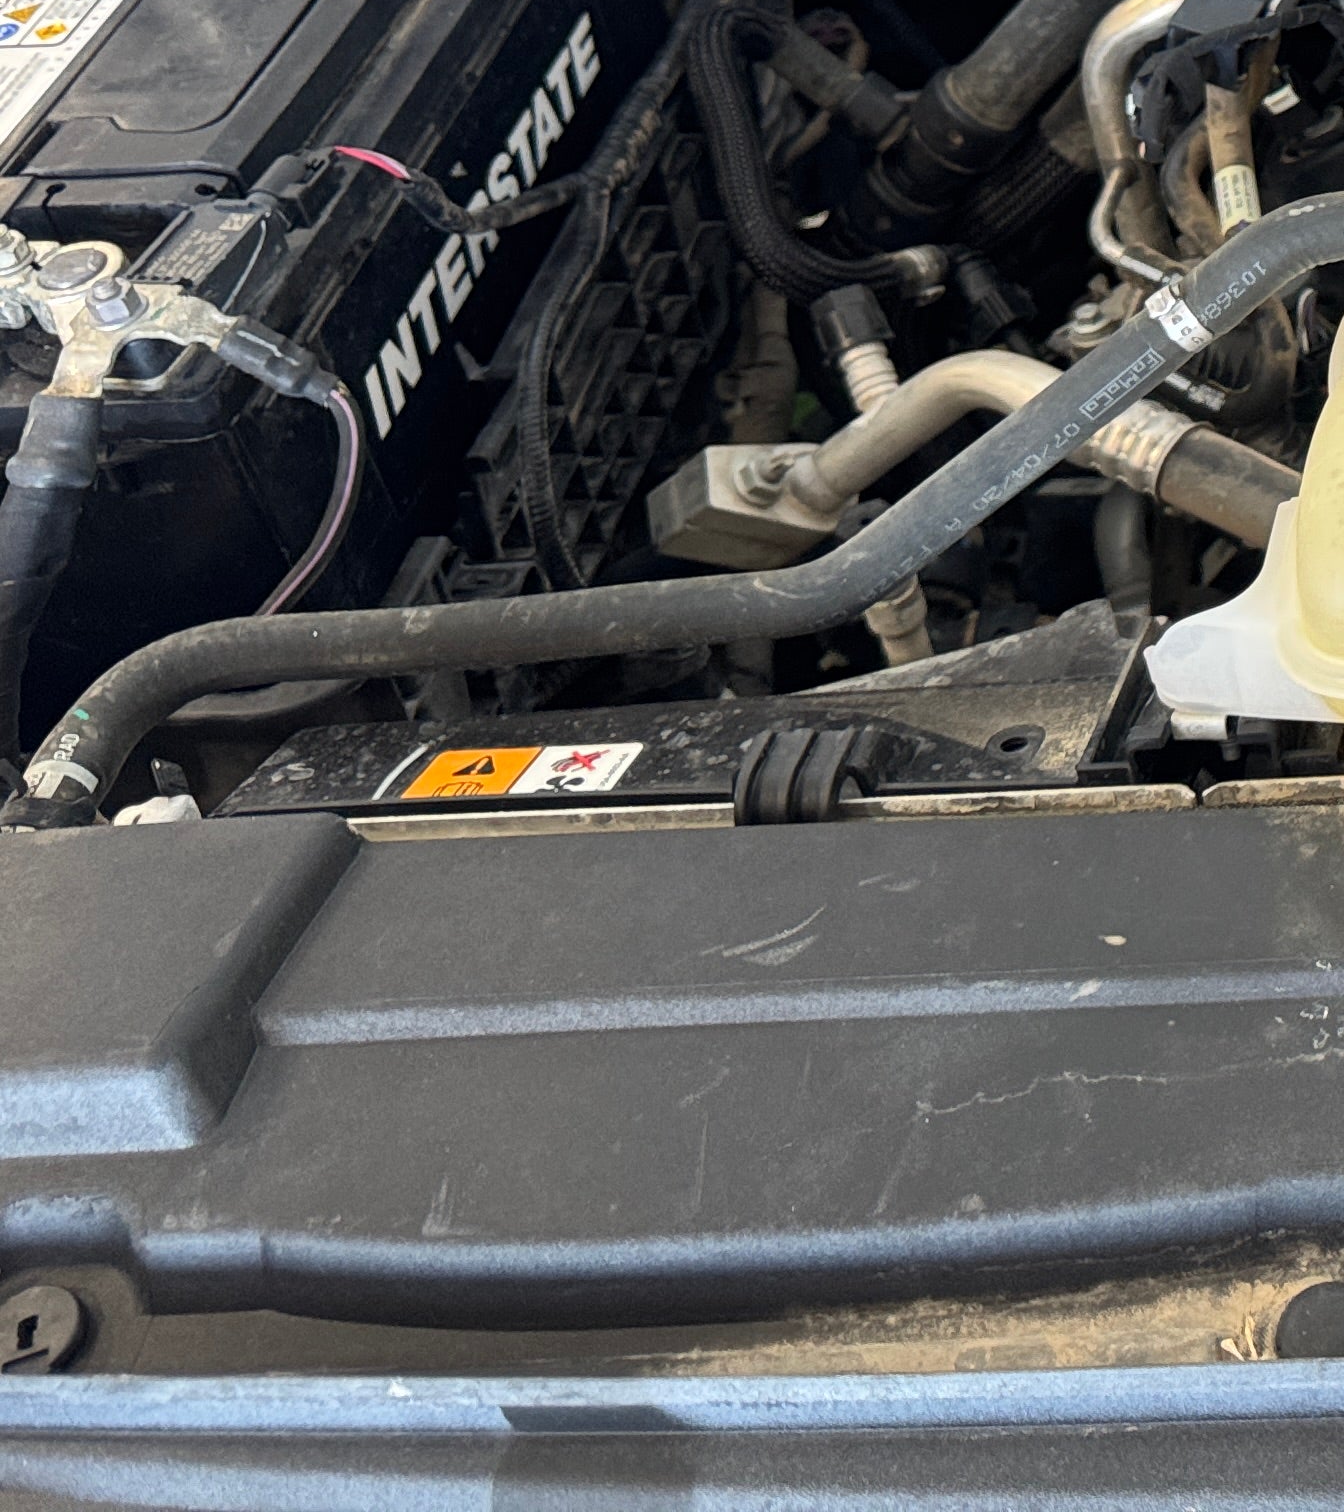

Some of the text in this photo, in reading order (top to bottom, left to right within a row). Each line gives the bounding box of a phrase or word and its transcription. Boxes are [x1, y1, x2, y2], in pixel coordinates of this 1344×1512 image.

[364, 11, 601, 440] INTERSTATE
[1082, 350, 1163, 419] FoMoCo
[972, 420, 1081, 513] 07/04/20
